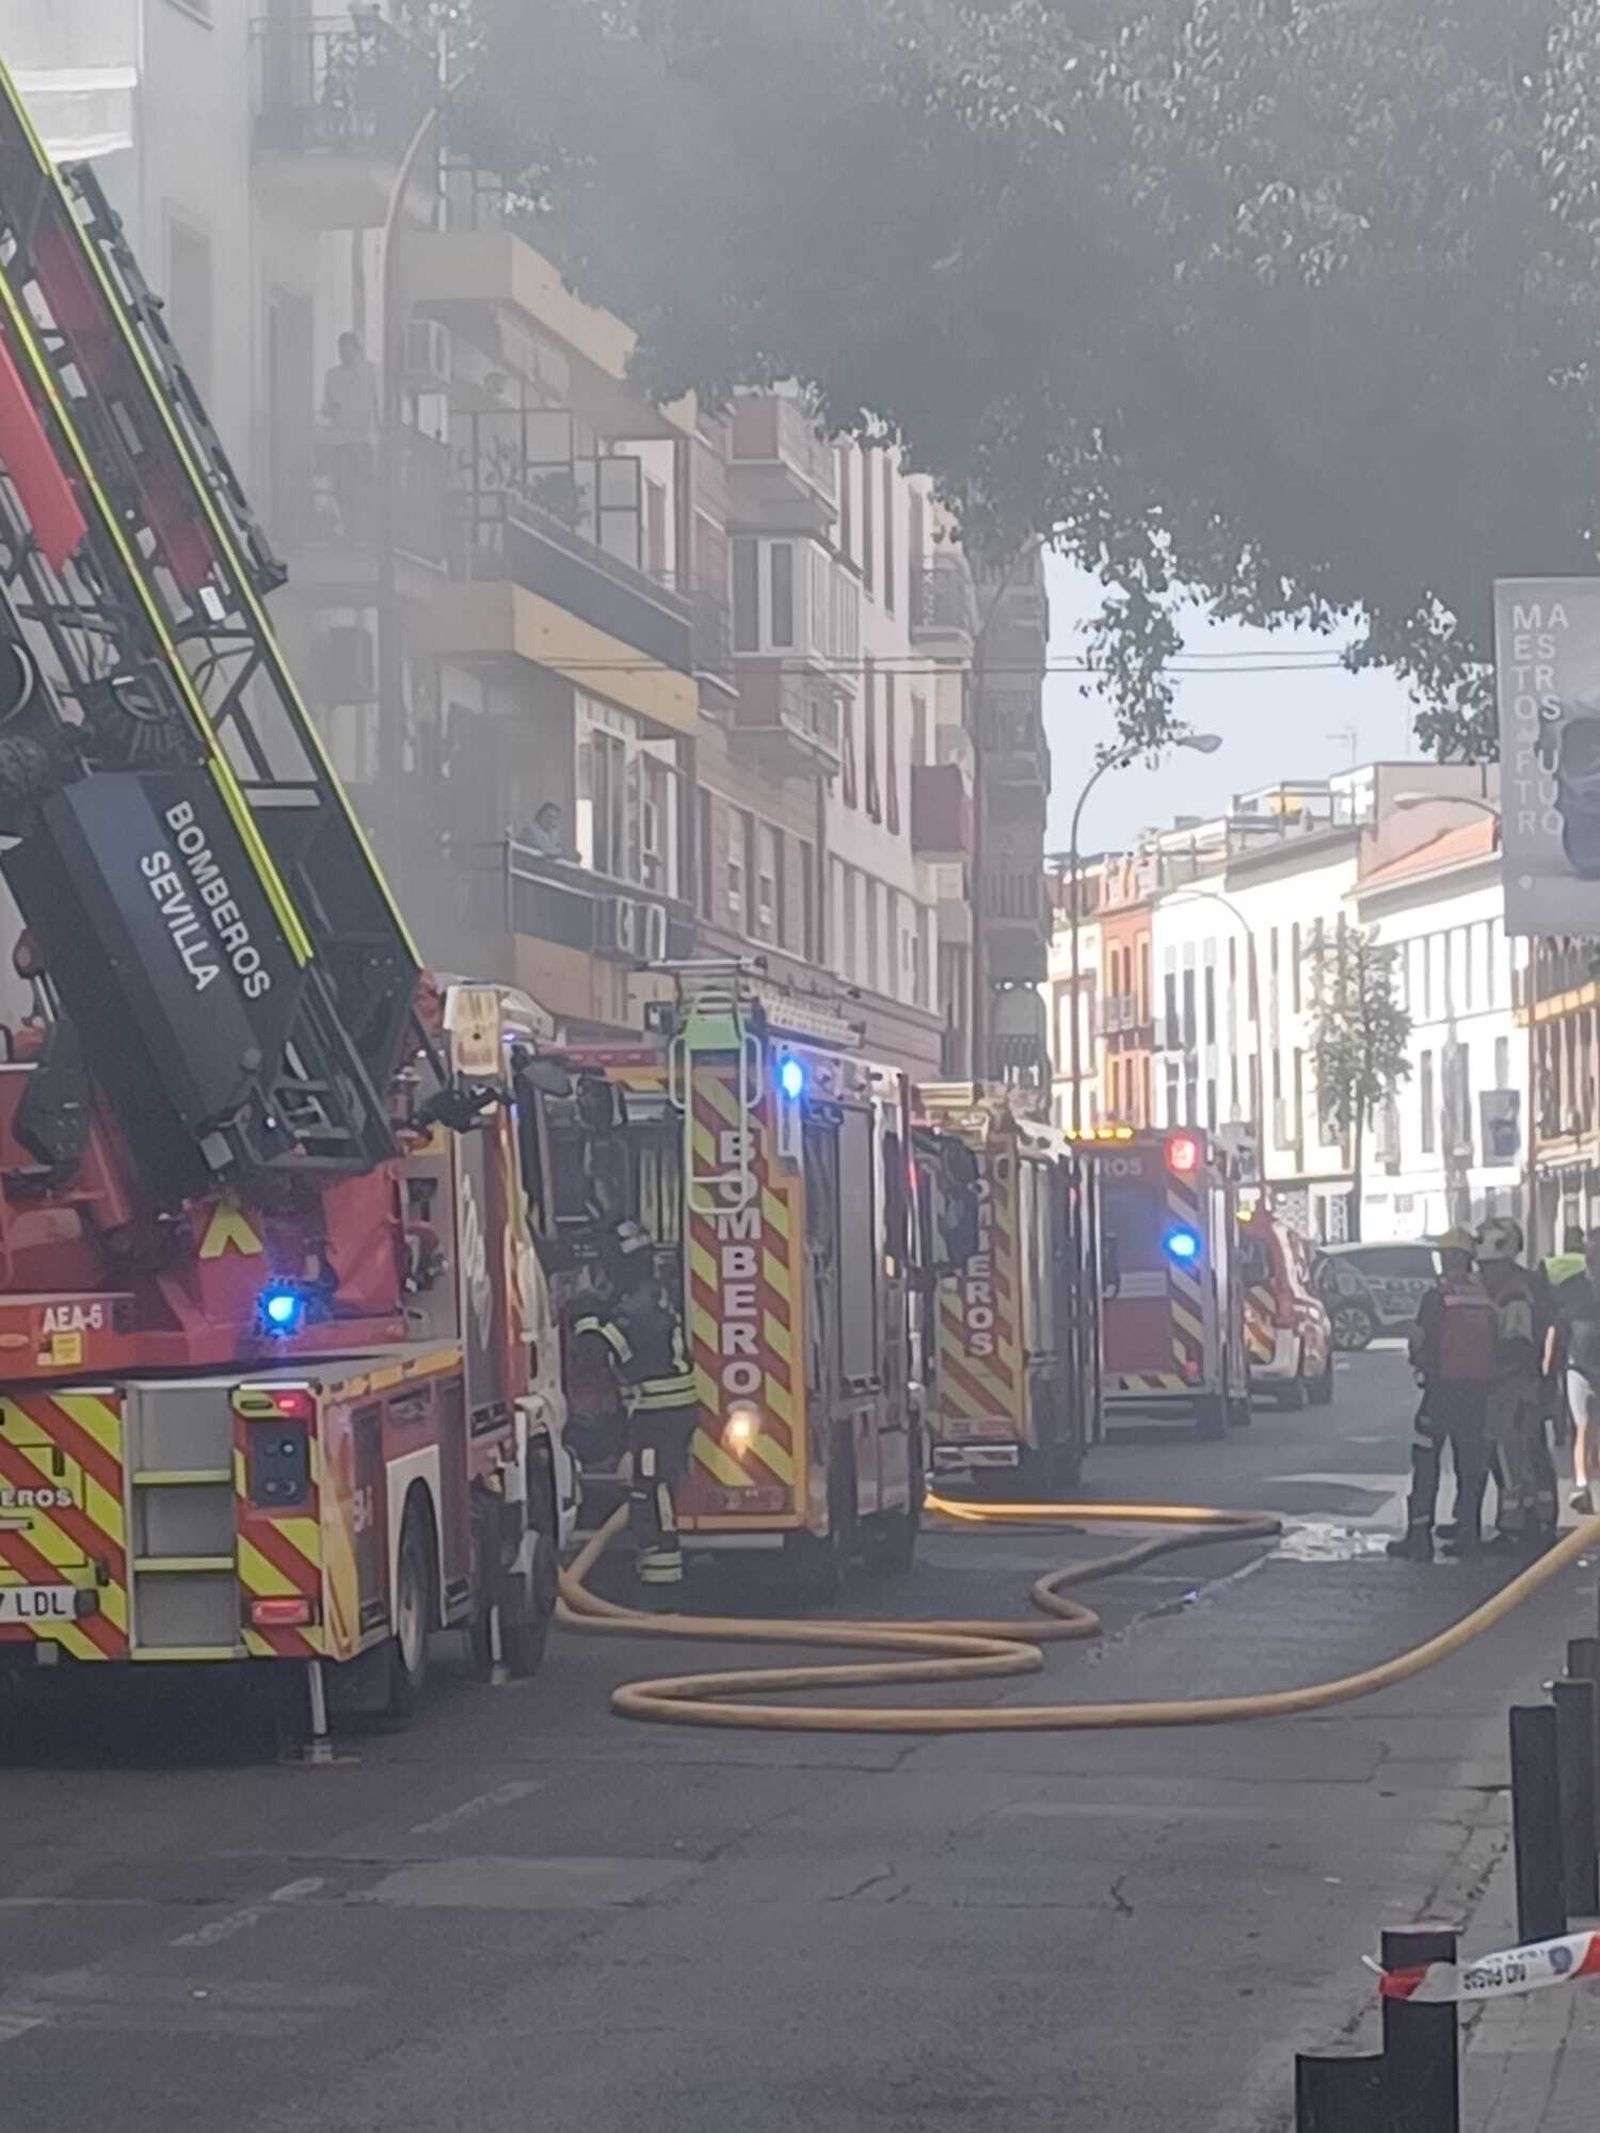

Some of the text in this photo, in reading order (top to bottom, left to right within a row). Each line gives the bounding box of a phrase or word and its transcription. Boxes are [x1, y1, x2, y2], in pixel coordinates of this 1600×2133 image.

[140, 850, 220, 991] SEVILLA
[165, 800, 271, 998] BOMBEROS
[717, 1130, 763, 1436] BOMBERO
[16, 1591, 67, 1616] LDL
